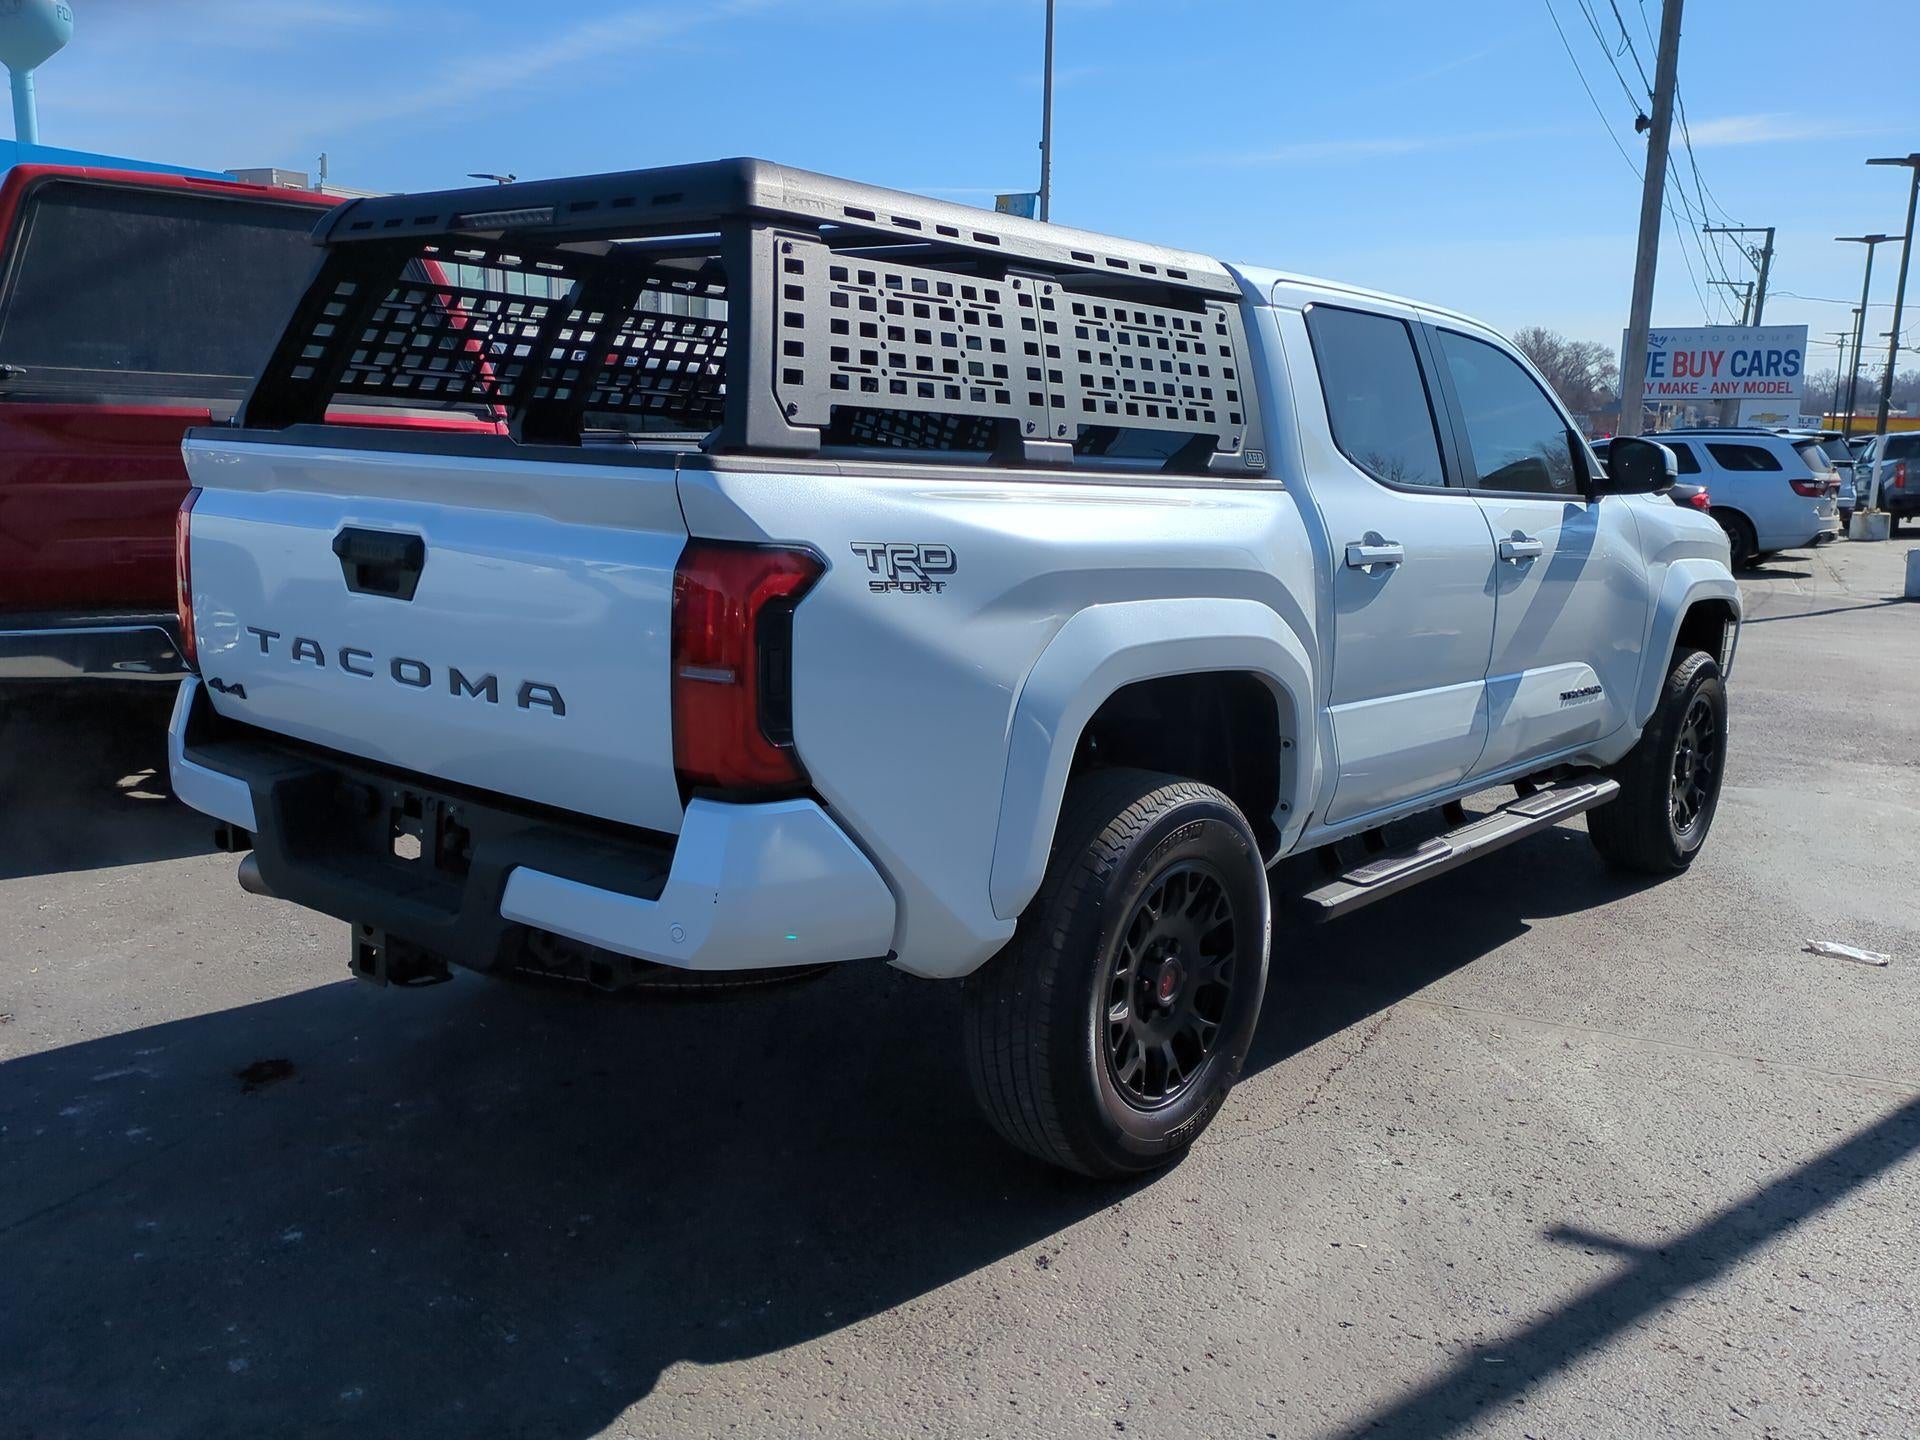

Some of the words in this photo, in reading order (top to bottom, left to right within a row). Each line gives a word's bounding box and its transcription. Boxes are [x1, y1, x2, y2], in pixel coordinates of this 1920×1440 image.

[1672, 350, 1725, 378] BUY
[1730, 349, 1800, 377] CARS
[1658, 382, 1699, 394] MAKE
[1710, 381, 1740, 394] ANY
[1743, 381, 1793, 394] MODEL
[850, 542, 957, 582] TRD
[869, 580, 947, 594] SPORT
[246, 625, 566, 717] TACOMA
